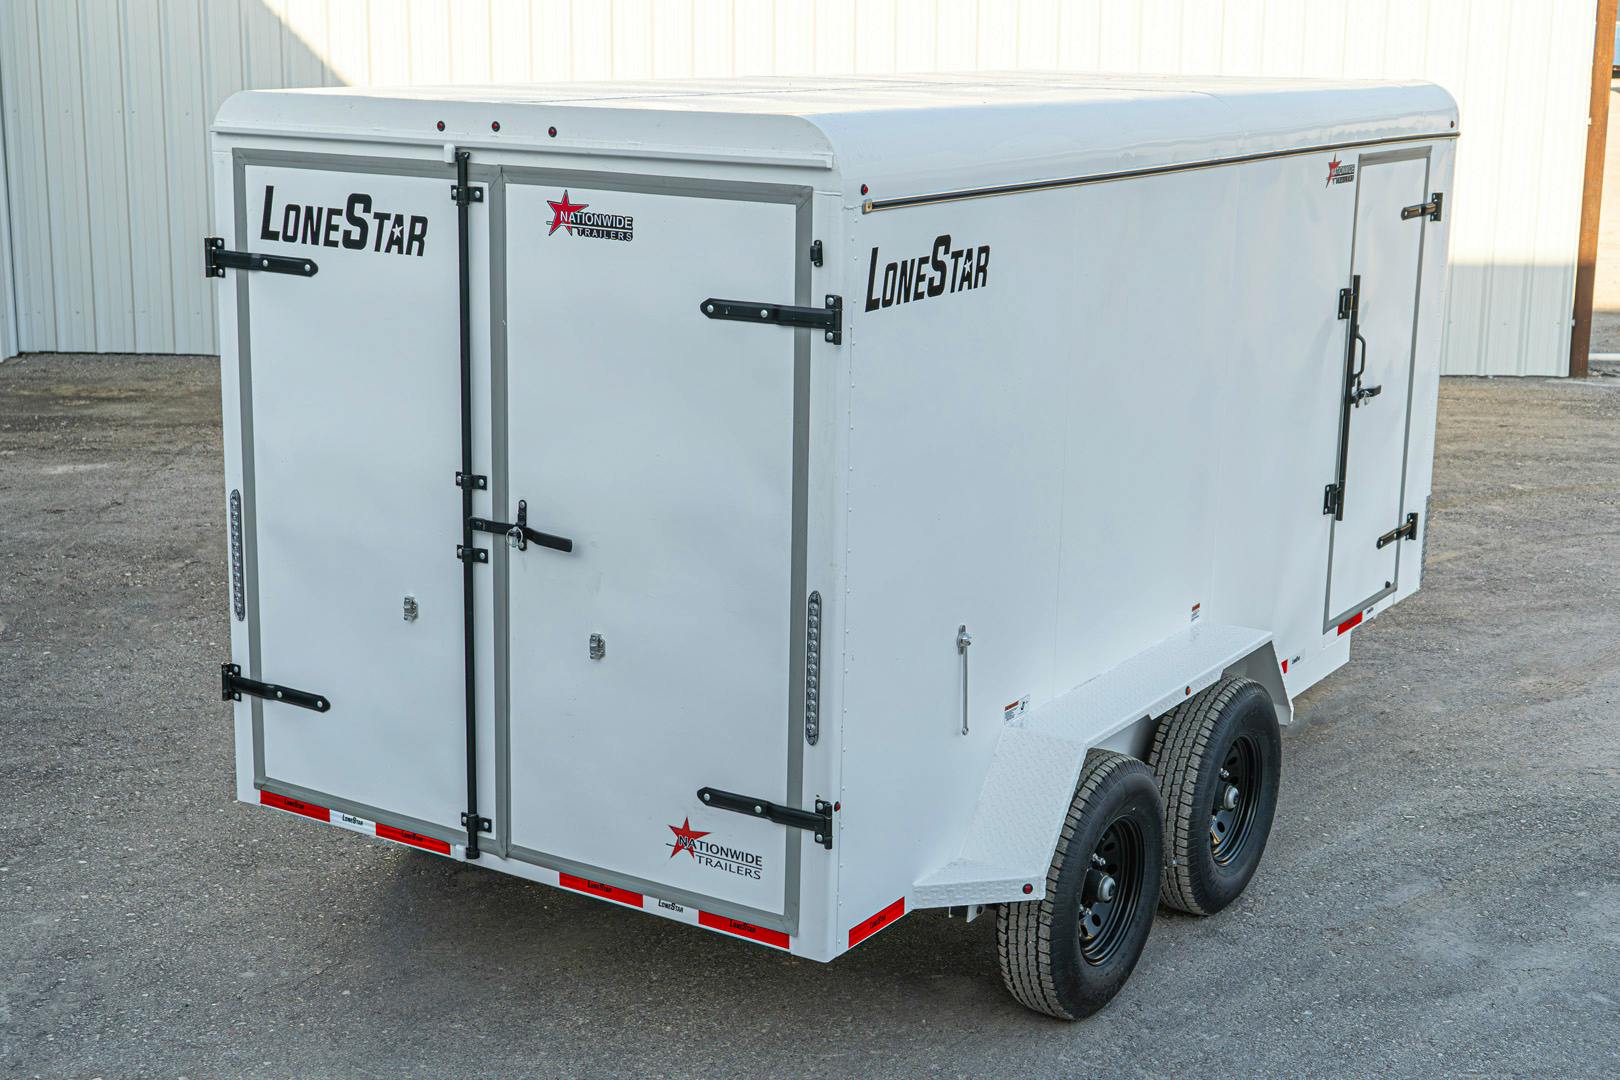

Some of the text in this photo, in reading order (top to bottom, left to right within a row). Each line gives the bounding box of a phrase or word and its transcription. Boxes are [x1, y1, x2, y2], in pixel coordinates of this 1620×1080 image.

[560, 210, 633, 229] NATIONWIDE
[577, 227, 633, 241] TRAILERS
[678, 835, 763, 867] NATIONWIDE
[695, 854, 761, 880] TRAILERS
